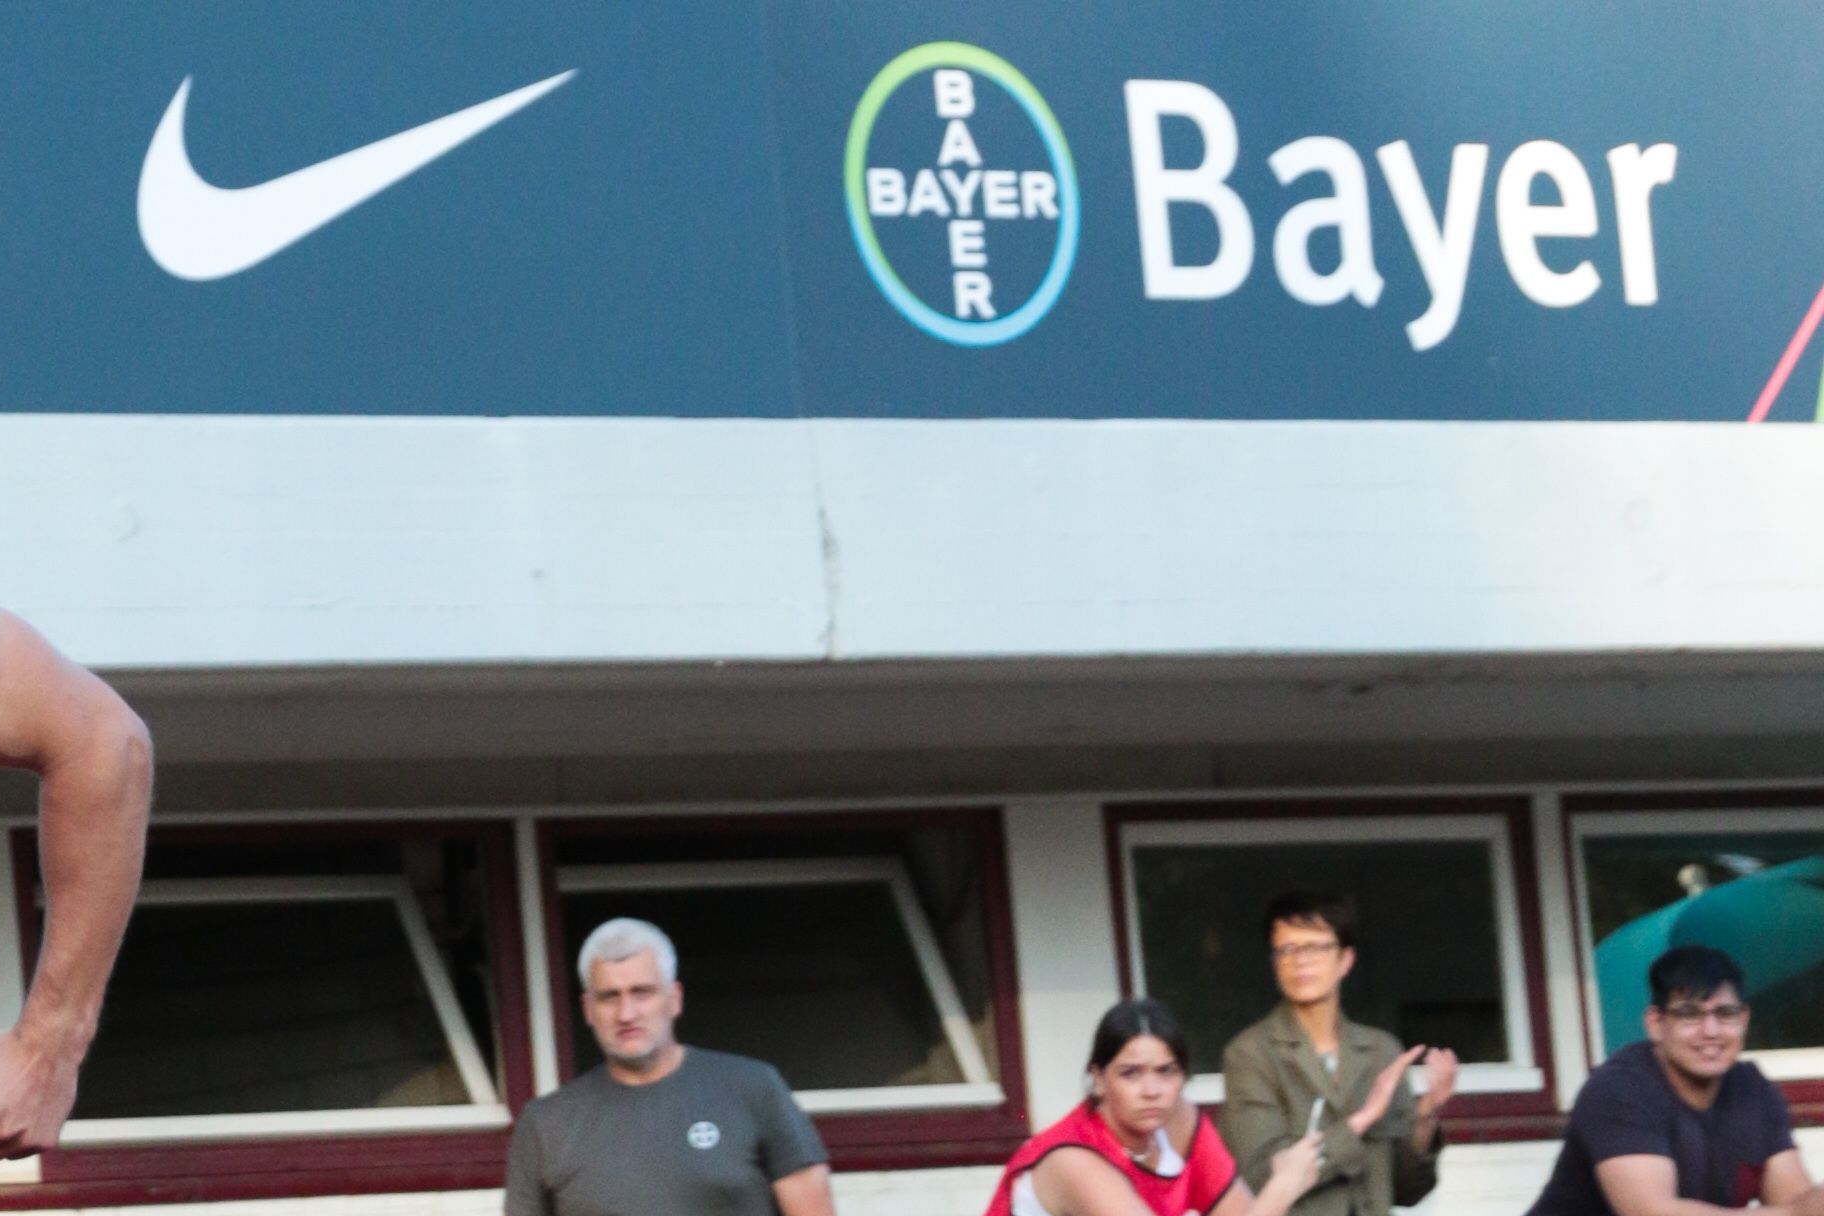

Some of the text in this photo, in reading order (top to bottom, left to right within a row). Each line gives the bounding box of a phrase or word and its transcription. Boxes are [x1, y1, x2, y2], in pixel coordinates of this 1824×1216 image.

[866, 167, 1059, 219] BAYER
[933, 68, 997, 320] BAYER
[1123, 79, 1679, 353] Bayer
